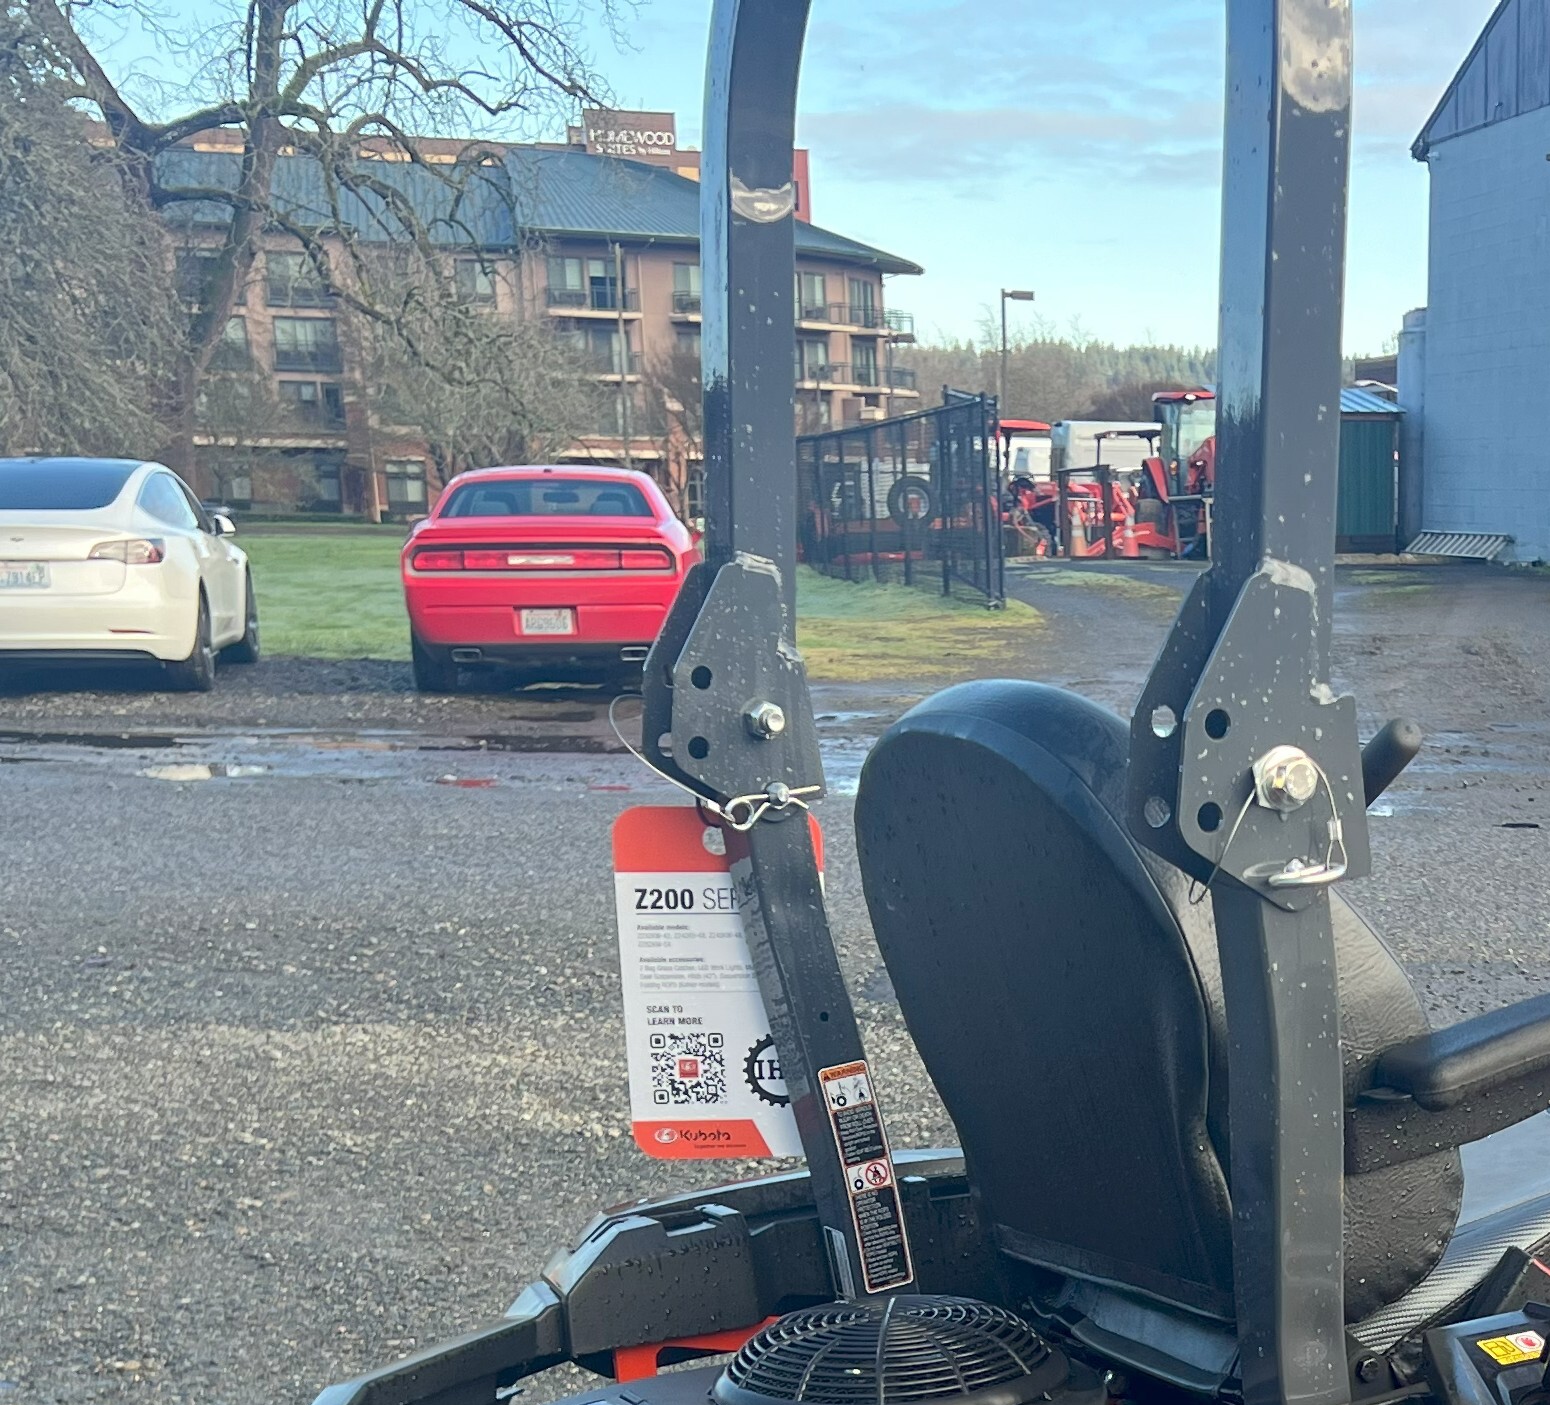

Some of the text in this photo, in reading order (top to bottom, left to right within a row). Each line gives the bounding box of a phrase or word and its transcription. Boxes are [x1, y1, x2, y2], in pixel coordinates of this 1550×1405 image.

[634, 888, 694, 910] Z200
[646, 1005, 684, 1014] SCAN TO
[647, 1017, 703, 1026] LEARN MORE
[680, 1129, 731, 1142] Kubota
